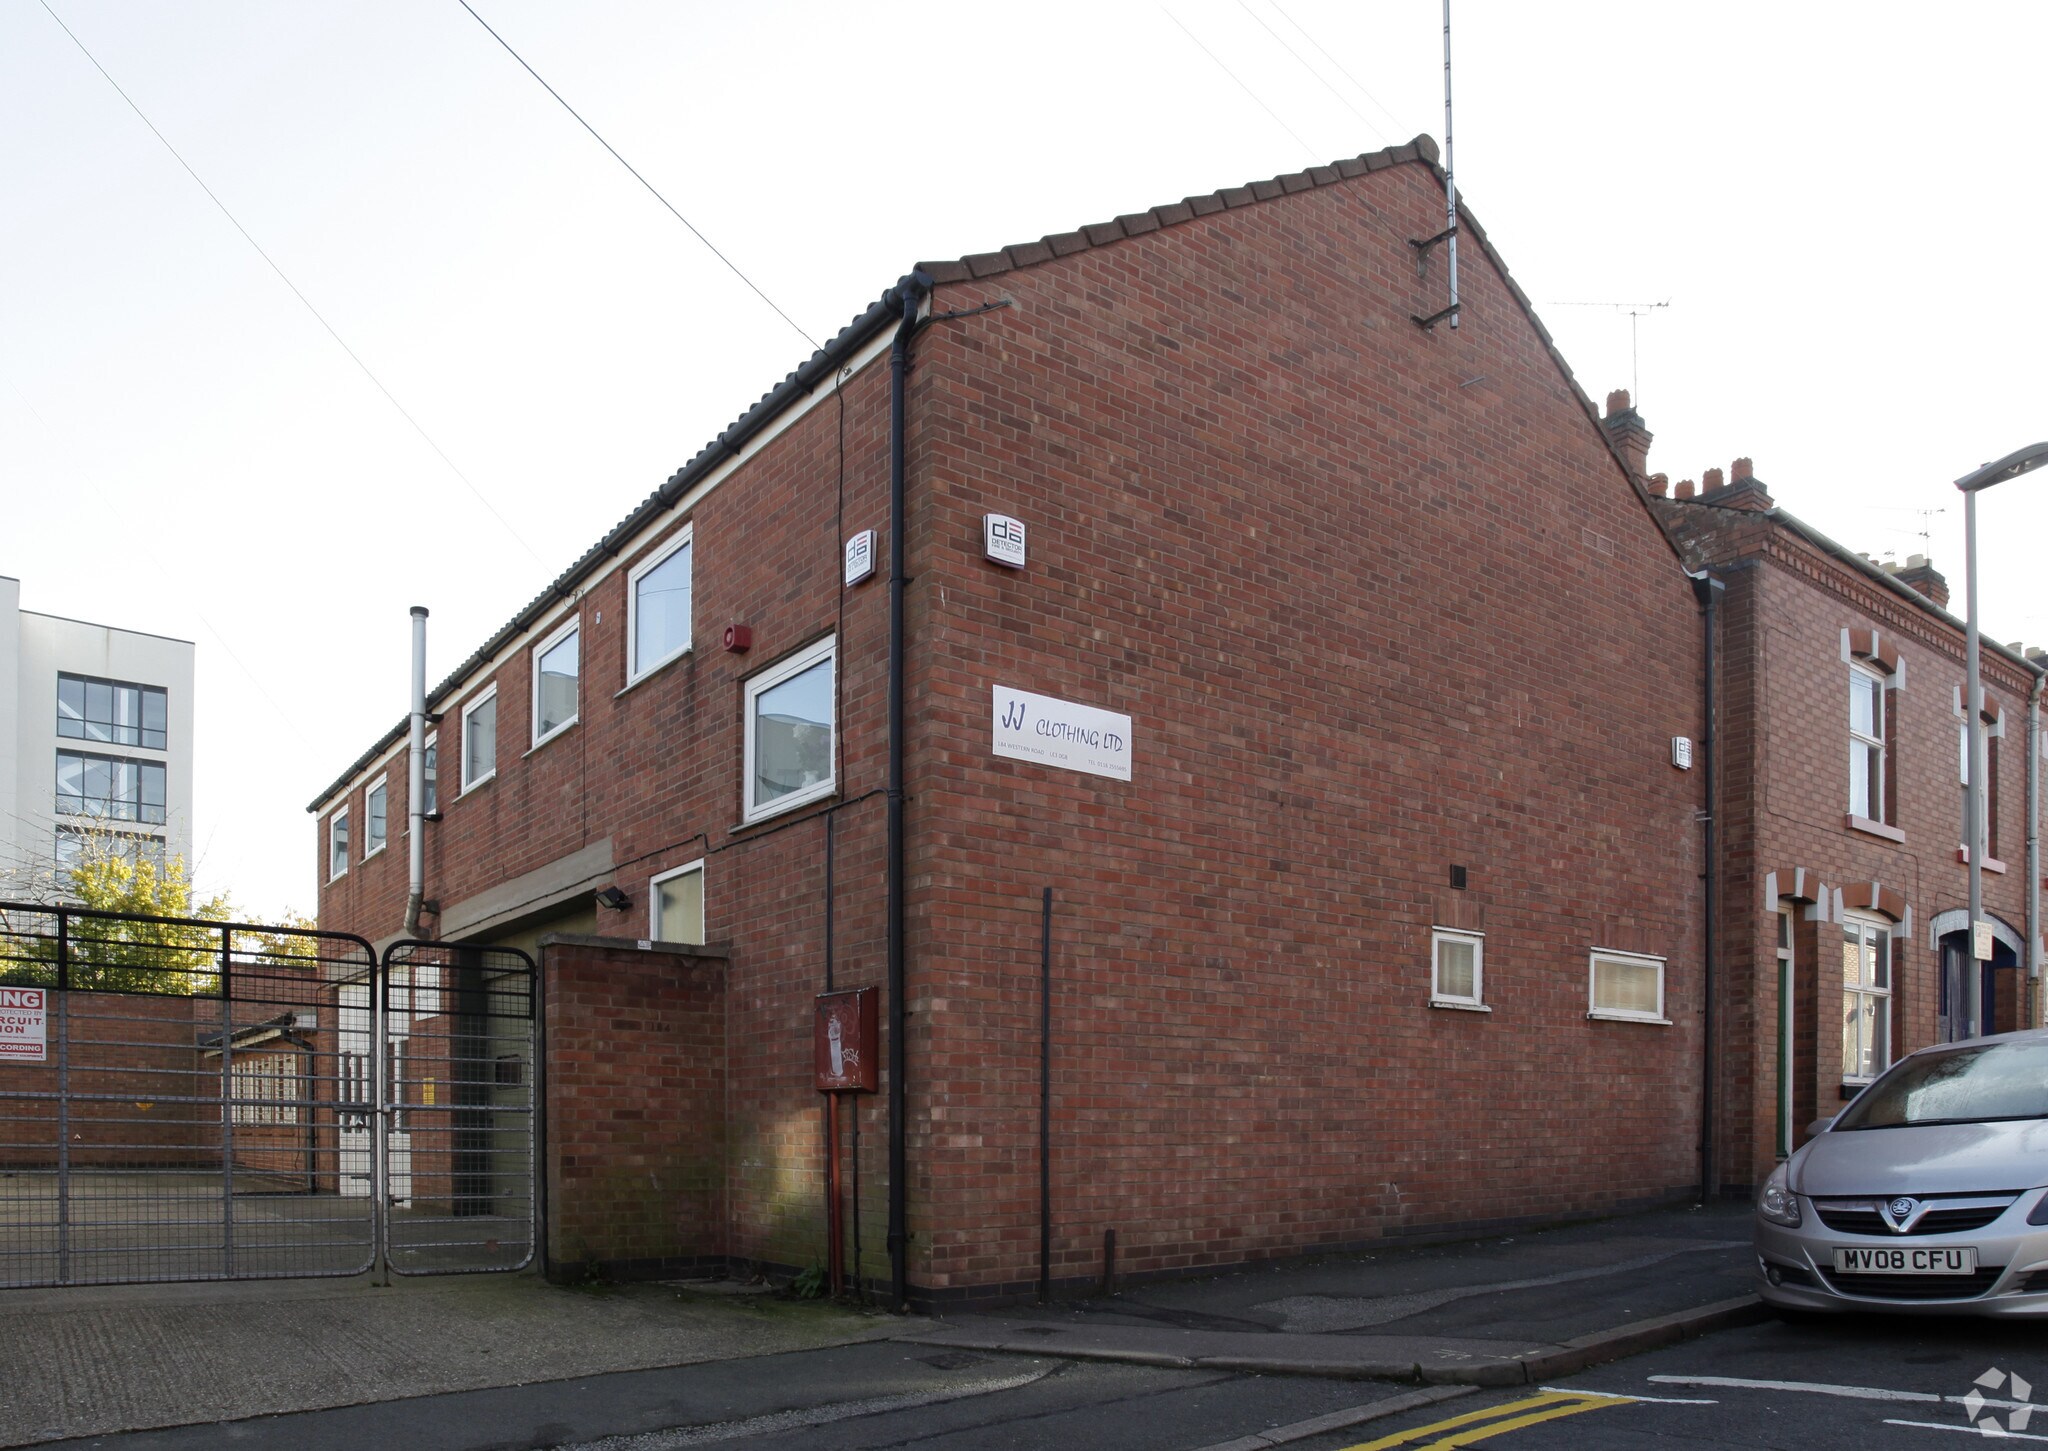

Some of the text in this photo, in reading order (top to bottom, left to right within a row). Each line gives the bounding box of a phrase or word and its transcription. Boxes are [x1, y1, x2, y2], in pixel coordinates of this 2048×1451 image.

[991, 538, 1022, 551] DETECTOR
[1001, 700, 1123, 752] JJ CLOTHING LTD
[1007, 743, 1031, 752] WESTERN
[1031, 748, 1045, 756] ROAD
[0, 1044, 41, 1052] CORDING
[1844, 1250, 1962, 1270] MV08 CFU
